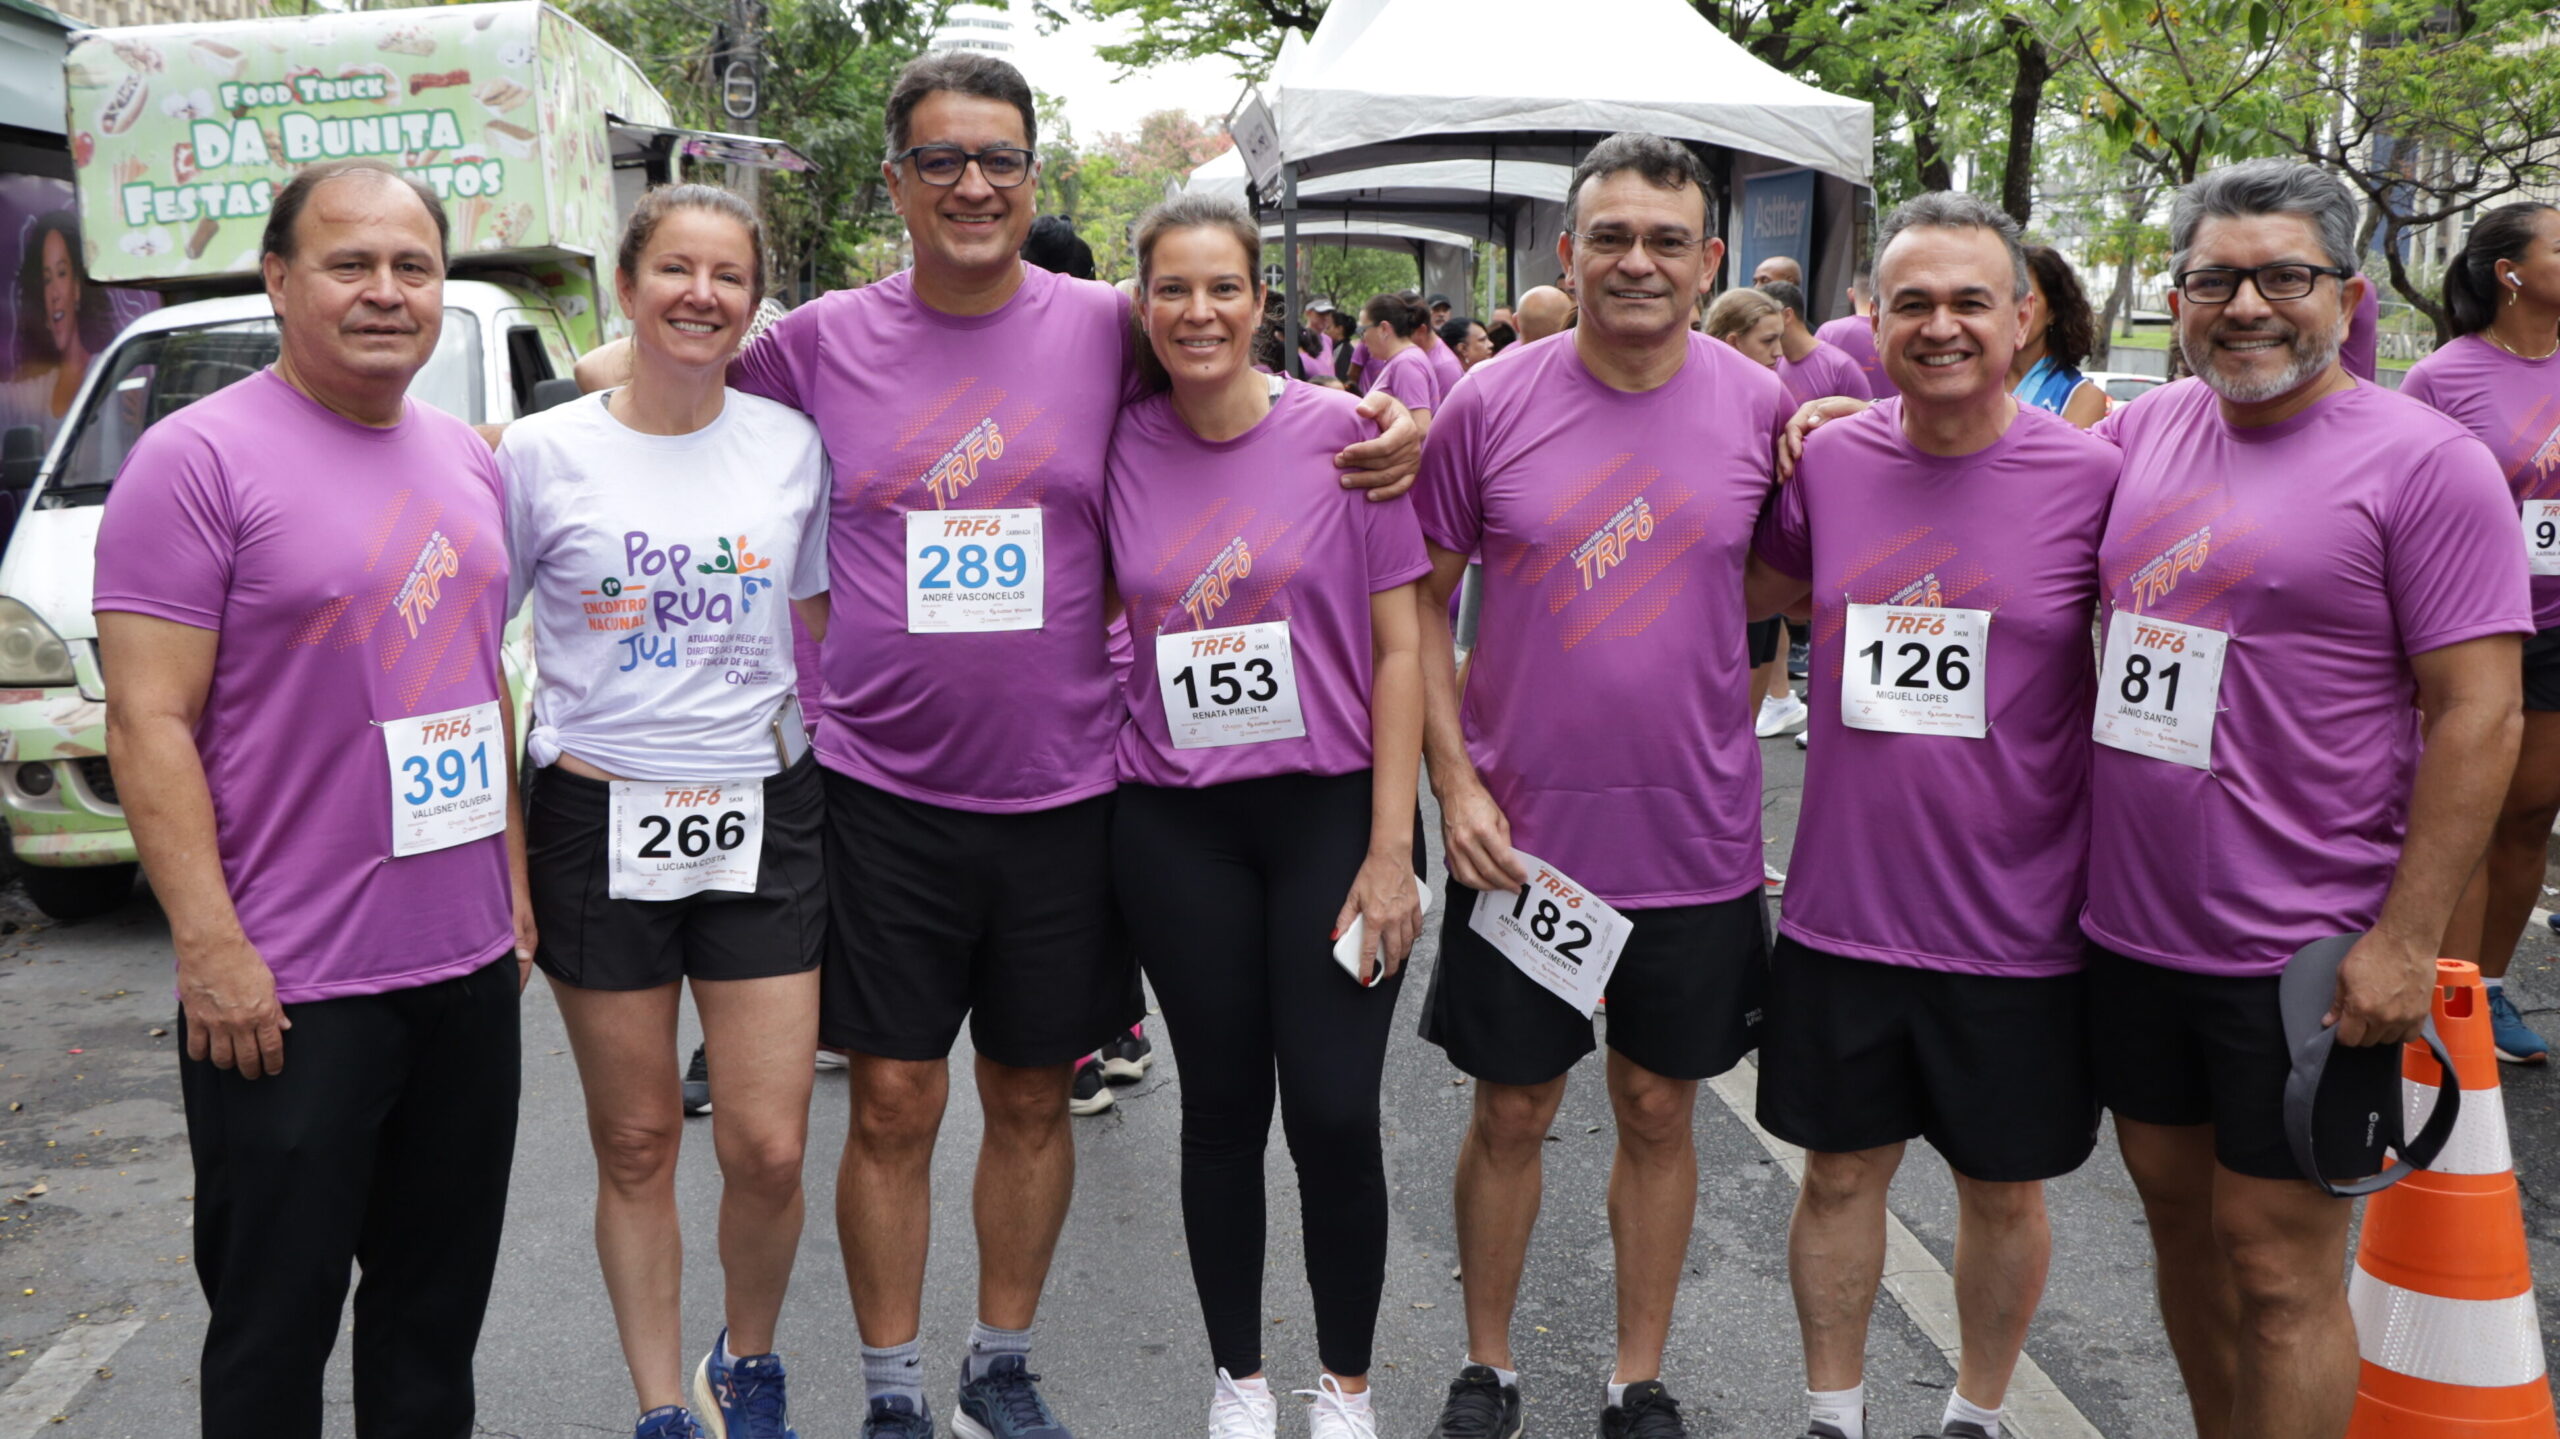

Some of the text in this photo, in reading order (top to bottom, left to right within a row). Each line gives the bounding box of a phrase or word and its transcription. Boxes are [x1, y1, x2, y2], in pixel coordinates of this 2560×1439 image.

[190, 109, 464, 169] DA BUNITA
[927, 423, 1004, 510] TRF6
[943, 519, 1002, 537] TRF6
[2536, 521, 2560, 549] 9
[1576, 502, 1654, 591] TRF6
[918, 543, 1027, 589] 289
[2132, 532, 2211, 615] TRF6
[399, 537, 458, 640] TRF6
[922, 591, 1025, 602] ANDRÉ VASCONCELOS
[1184, 541, 1252, 630] TRF6
[583, 597, 647, 614] ENCONTRO
[736, 634, 757, 643] REDE
[1885, 616, 1946, 636] TRF6
[2134, 626, 2187, 654] TRF6
[734, 646, 768, 656] PESSOAS
[1191, 635, 1247, 658] TRF6
[1254, 643, 1270, 651] 5KM
[730, 658, 742, 666] DE
[743, 659, 760, 668] RUA
[1859, 640, 1970, 691] 126
[1173, 658, 1278, 708] 153
[1876, 690, 1949, 703] MIGUEL LOPES
[2121, 653, 2182, 712] 81
[1192, 705, 1269, 720] RENATA PIMENTA
[2143, 711, 2178, 728] SANTOS
[421, 718, 472, 746] TRF6
[402, 741, 490, 806] 391
[411, 793, 493, 820] VALLISNEY OLIVEIRA
[664, 788, 722, 808] TRF6
[637, 810, 746, 859] 266
[656, 854, 726, 871] LUCIANA COSTA
[1535, 869, 1585, 909] TRF6
[1512, 883, 1592, 966] 182
[1530, 938, 1578, 976] NASCIMENTO
